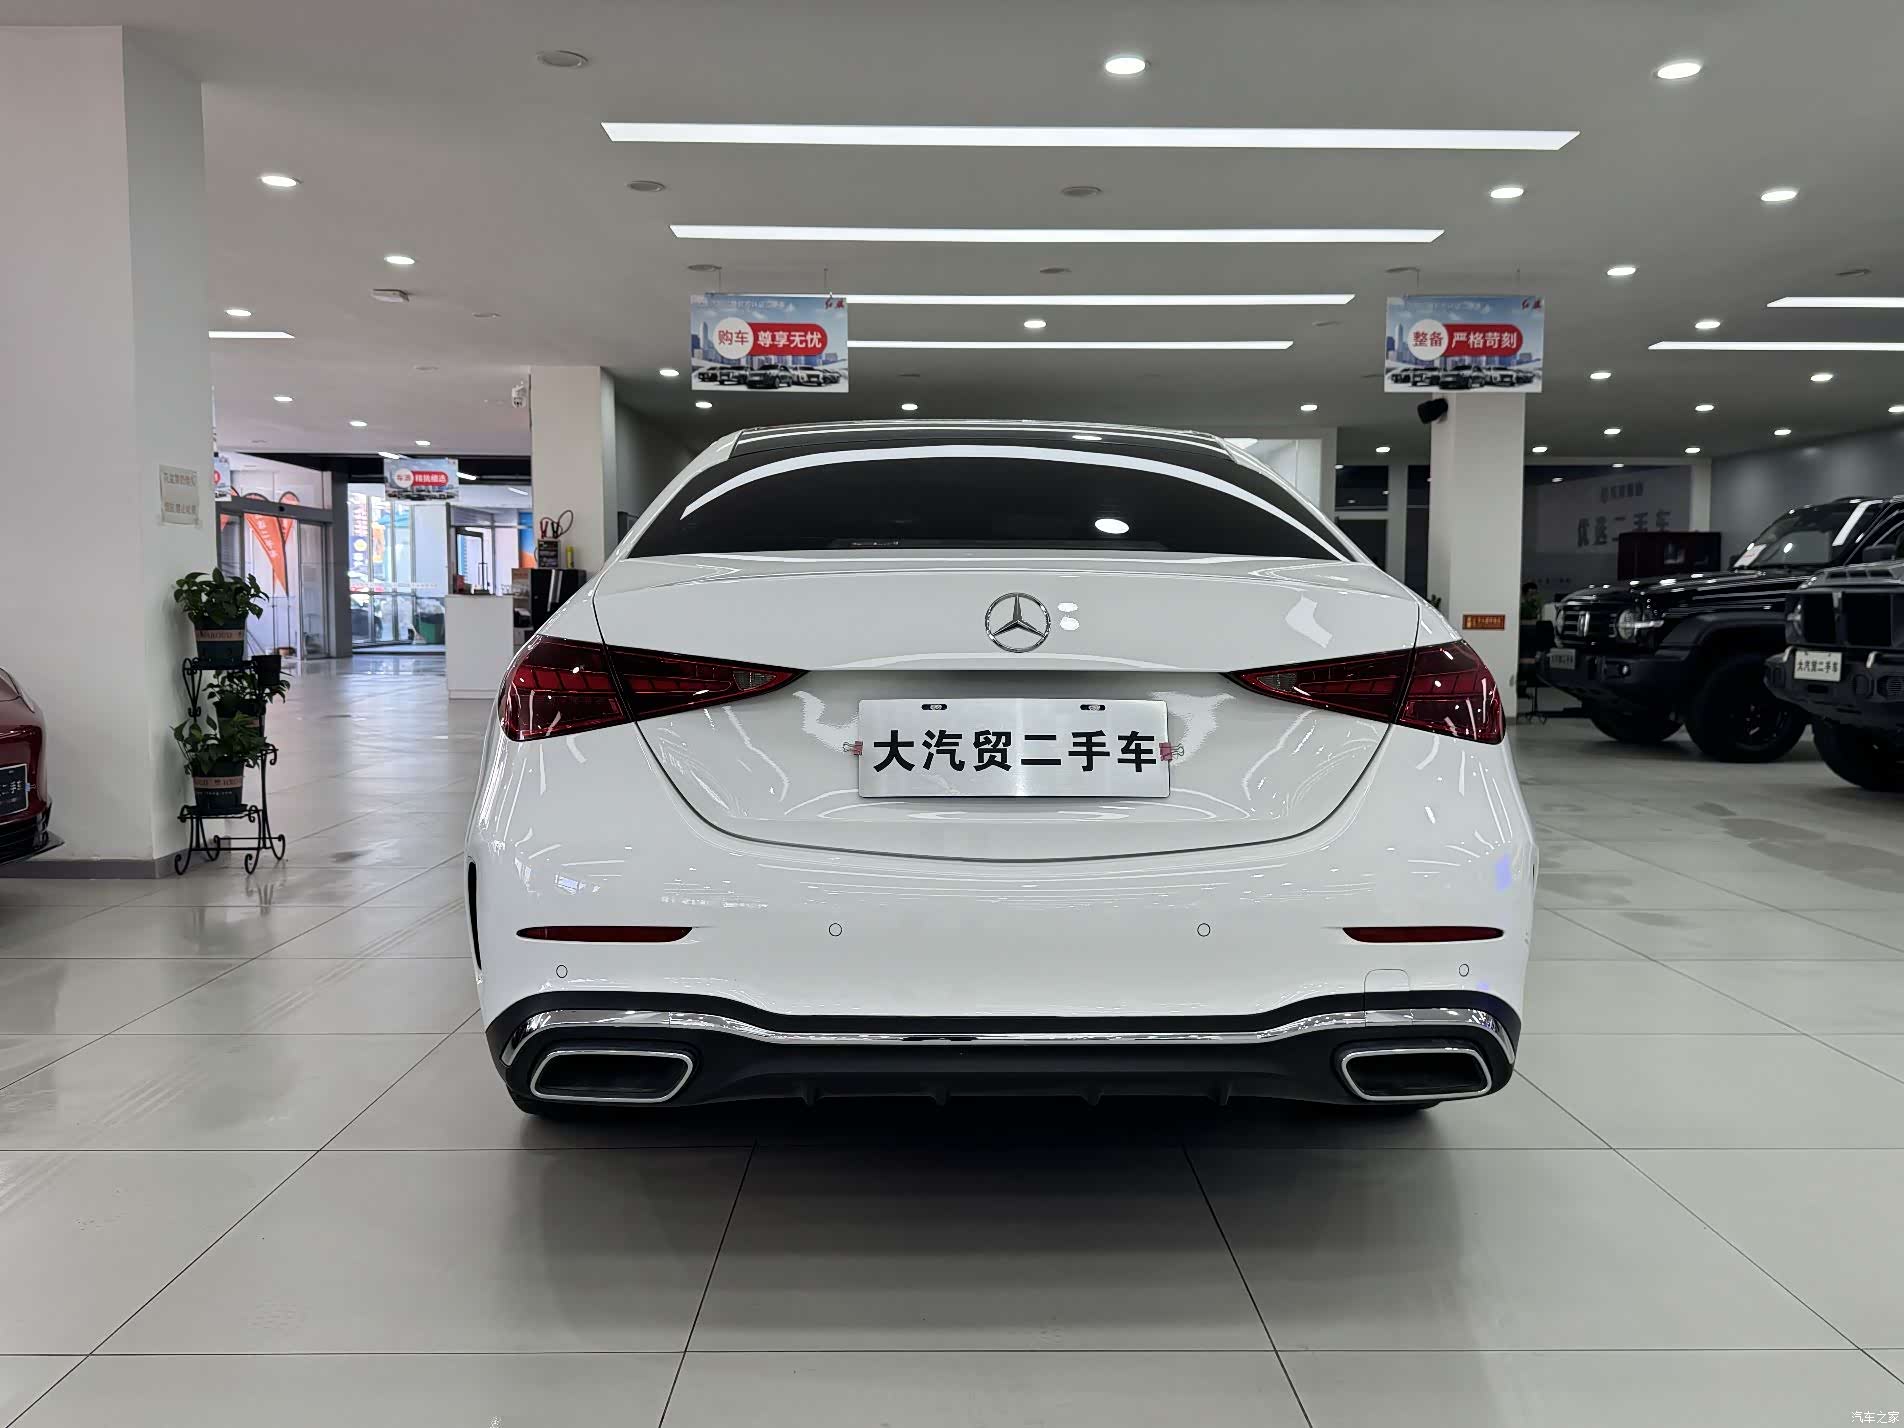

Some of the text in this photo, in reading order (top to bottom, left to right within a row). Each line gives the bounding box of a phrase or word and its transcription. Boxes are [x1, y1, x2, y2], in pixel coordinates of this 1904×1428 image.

[717, 330, 822, 348] 购车 尊享无忧
[1413, 332, 1517, 349] 整备 严格苛刻
[1797, 660, 1839, 674] 大汽贸二手车
[873, 729, 1157, 773] 大汽贸二手车
[0, 780, 24, 796] 二手车
